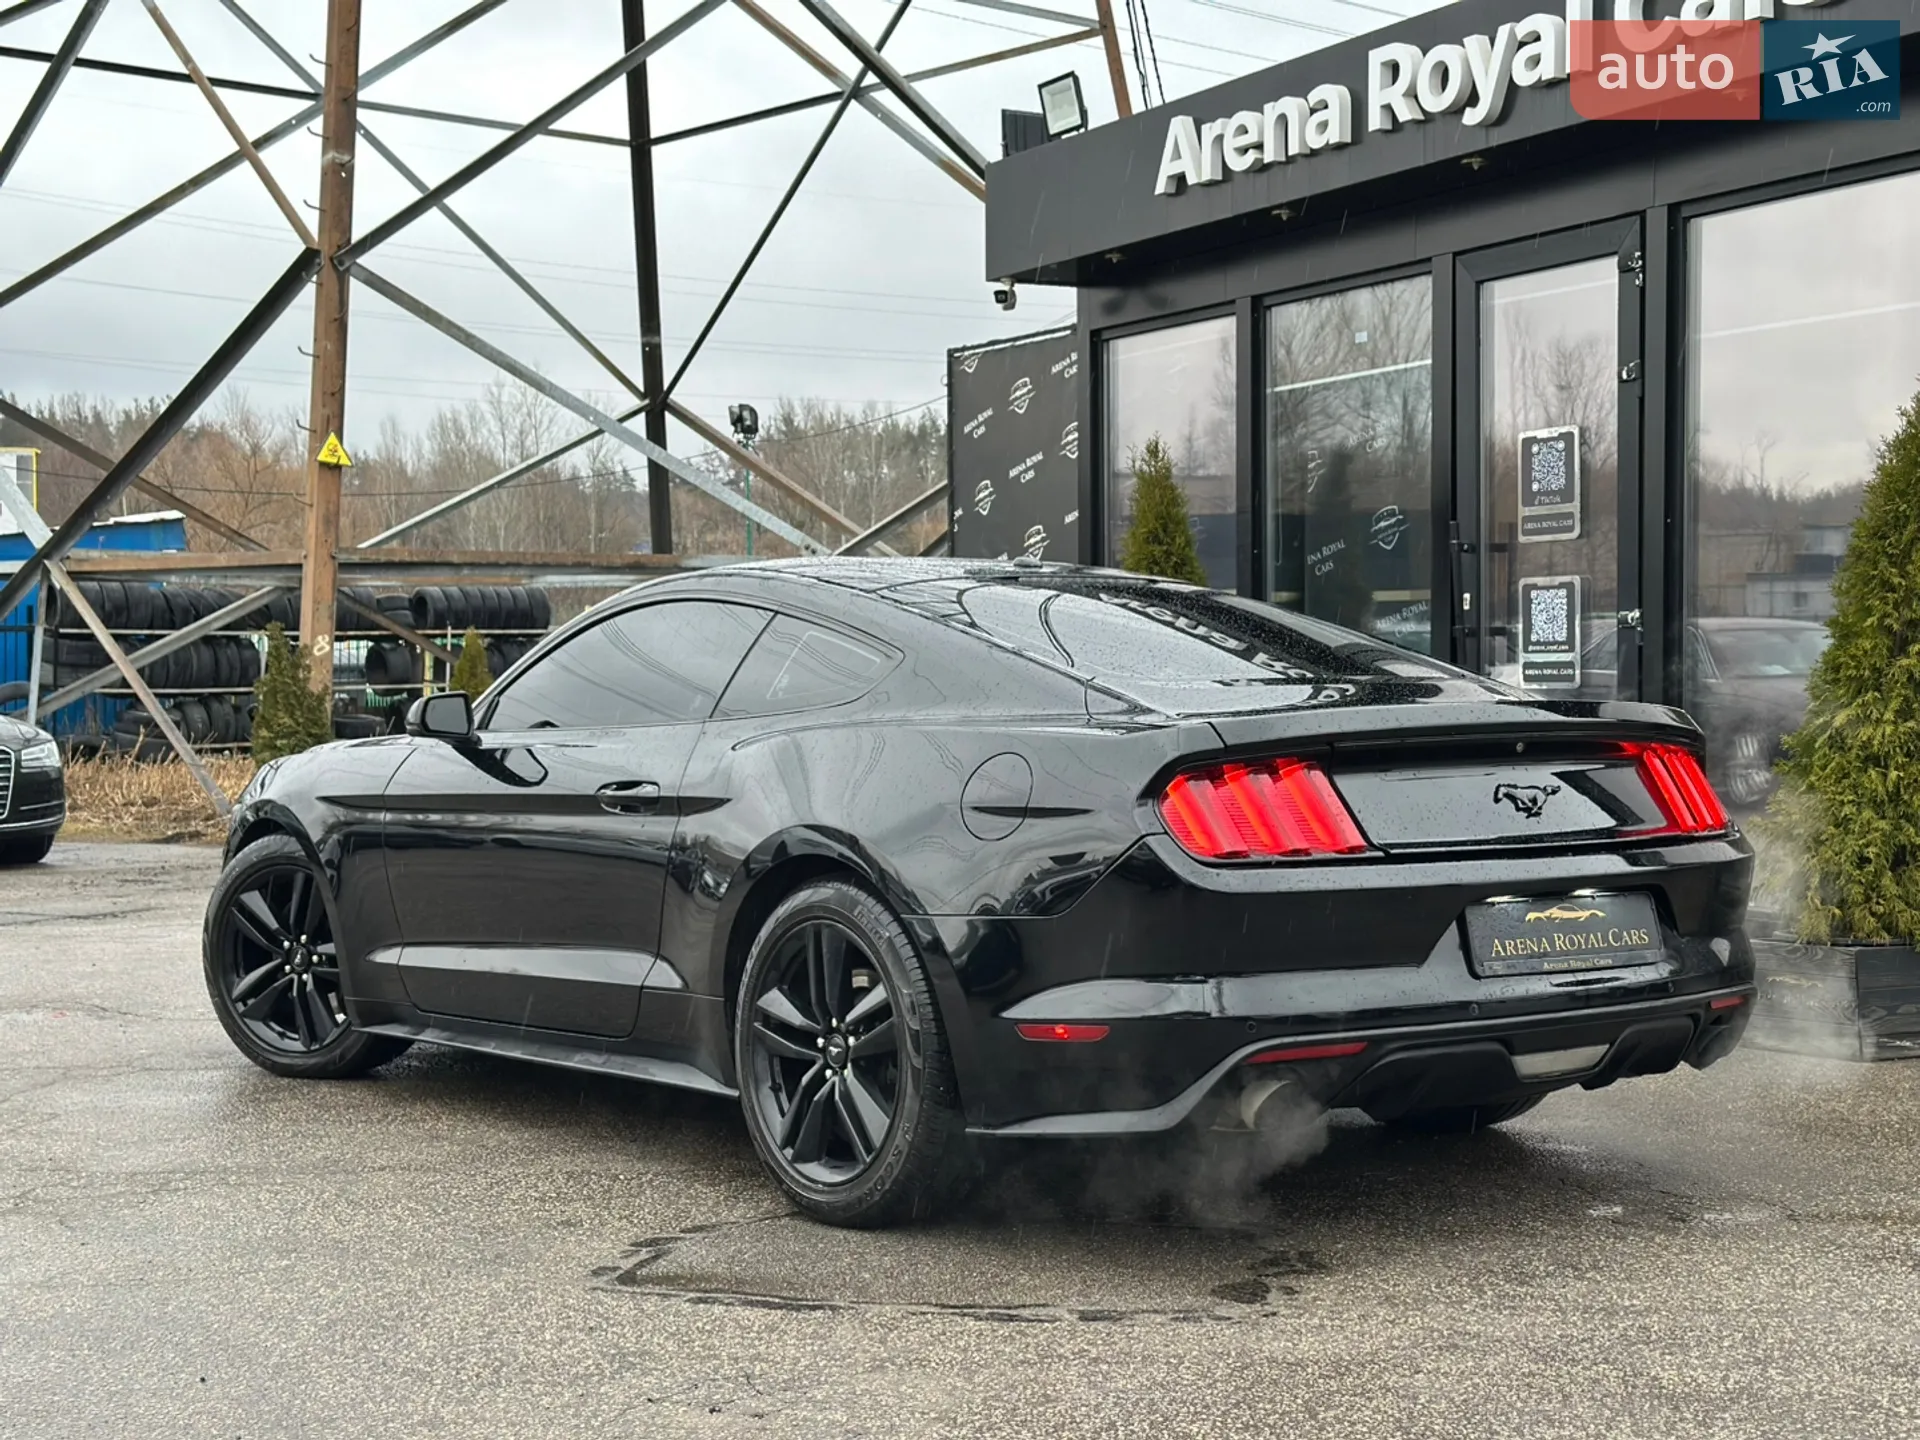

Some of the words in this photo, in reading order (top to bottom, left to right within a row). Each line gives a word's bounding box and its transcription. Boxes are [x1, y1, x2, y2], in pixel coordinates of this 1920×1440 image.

[1154, 83, 1352, 195] Arena
[1368, 0, 1594, 133] Royal
[1306, 551, 1322, 565] ENA
[1321, 538, 1346, 557] ROYAL
[1314, 560, 1334, 576] CARS
[1401, 600, 1428, 620] ROYAL
[1491, 938, 1551, 957] ARENA
[1553, 931, 1607, 951] ROYAL
[1608, 927, 1649, 947] CARS
